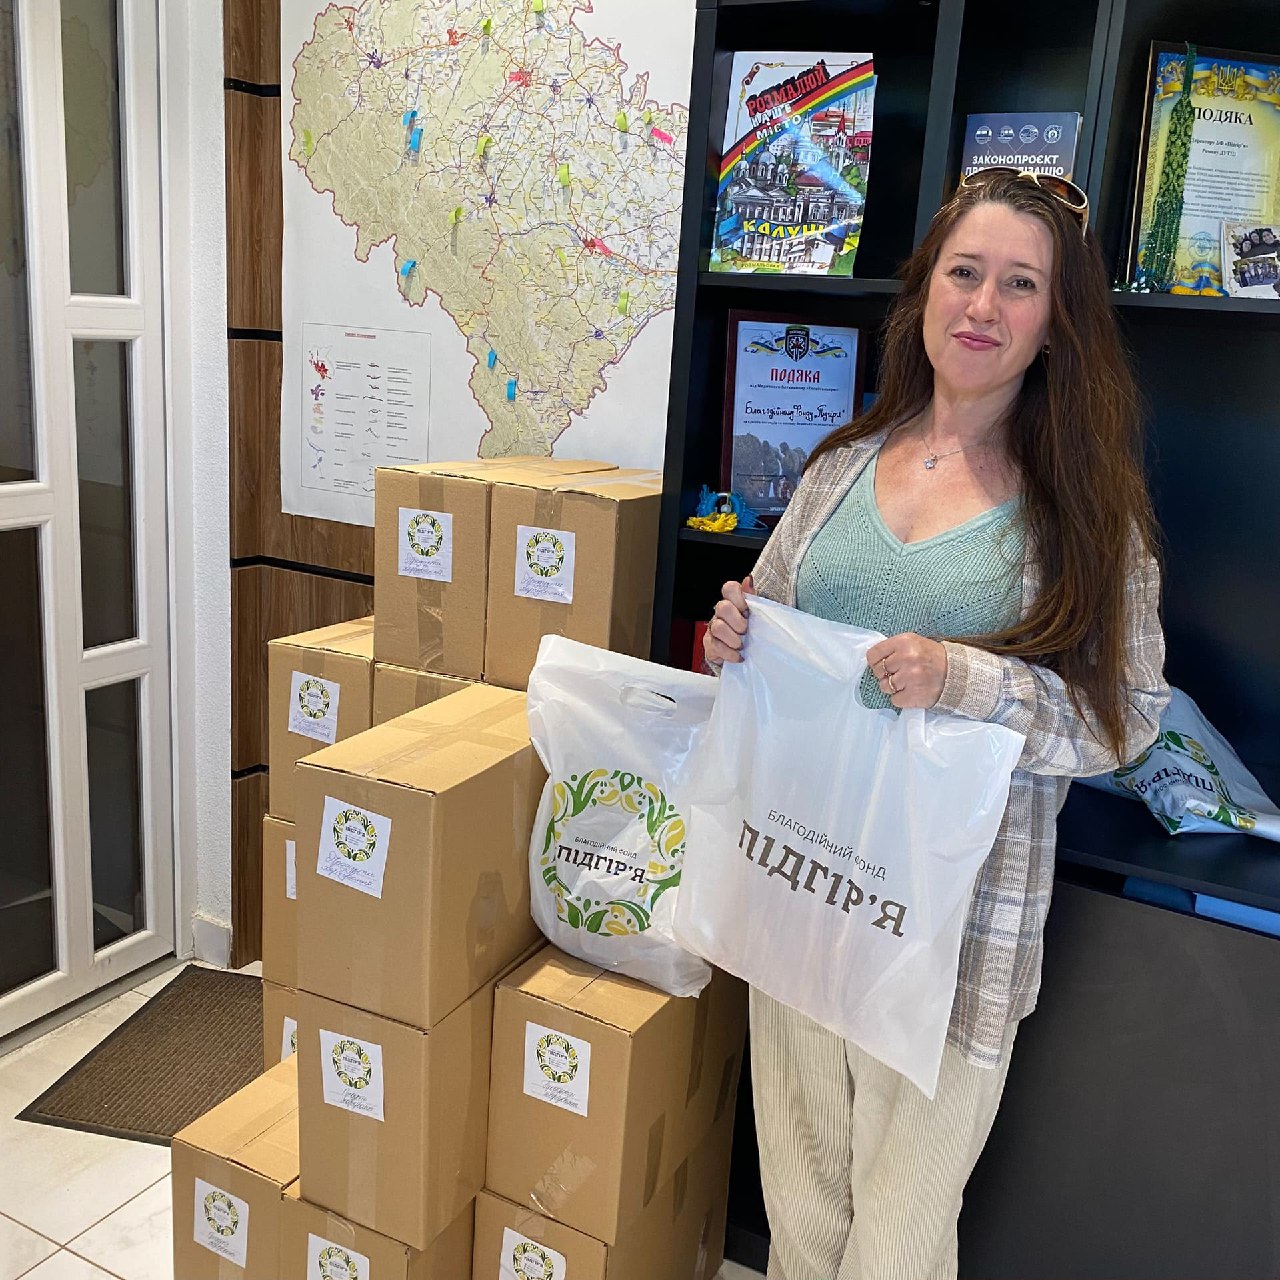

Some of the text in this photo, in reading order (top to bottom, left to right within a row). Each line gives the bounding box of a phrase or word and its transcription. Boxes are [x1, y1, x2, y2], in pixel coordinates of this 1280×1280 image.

[747, 65, 829, 116] РОЗМАЛЮЙ
[1194, 106, 1254, 126] ПОДЯКА
[972, 155, 1060, 165] ЗАКОНОПРОЄКТ
[743, 219, 826, 238] КАЛУШ
[770, 368, 820, 383] ПОДЯКА
[768, 809, 887, 882] БЛАГОДІЙНИЙ ФОНД
[556, 844, 646, 884] ПІДГІР'Я
[738, 819, 909, 938] ПІДГІР'Я
